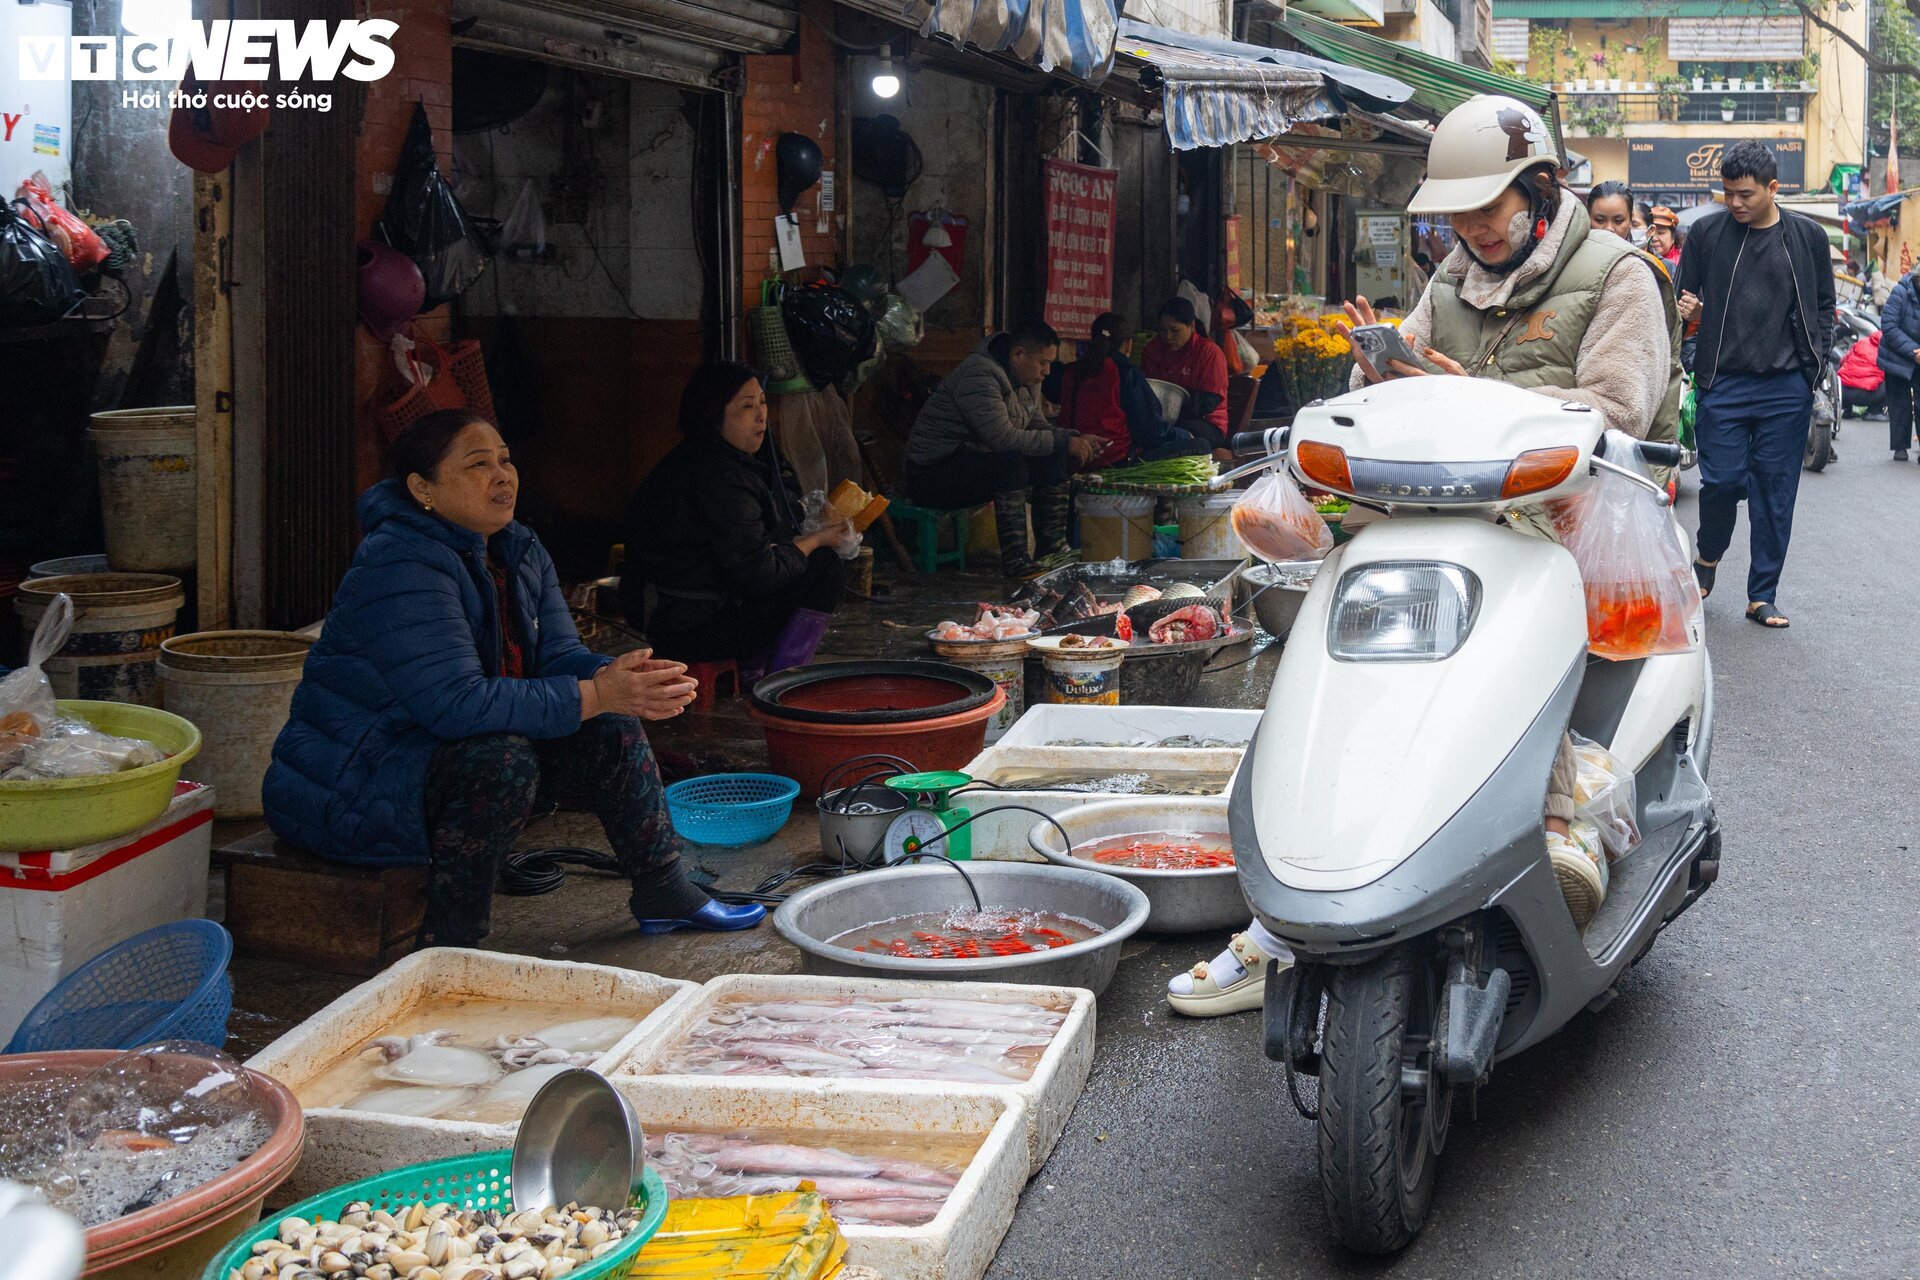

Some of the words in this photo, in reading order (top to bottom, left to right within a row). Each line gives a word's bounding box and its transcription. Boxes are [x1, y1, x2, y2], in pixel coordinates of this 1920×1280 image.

[0, 112, 22, 142] Y
[1632, 143, 1654, 151] SALON
[1686, 143, 1724, 170] Ti
[1690, 168, 1709, 177] Hair
[1710, 168, 1722, 177] De
[1091, 179, 1114, 201] AN
[1377, 484, 1477, 496] HONDA
[1066, 685, 1100, 695] Dulux
